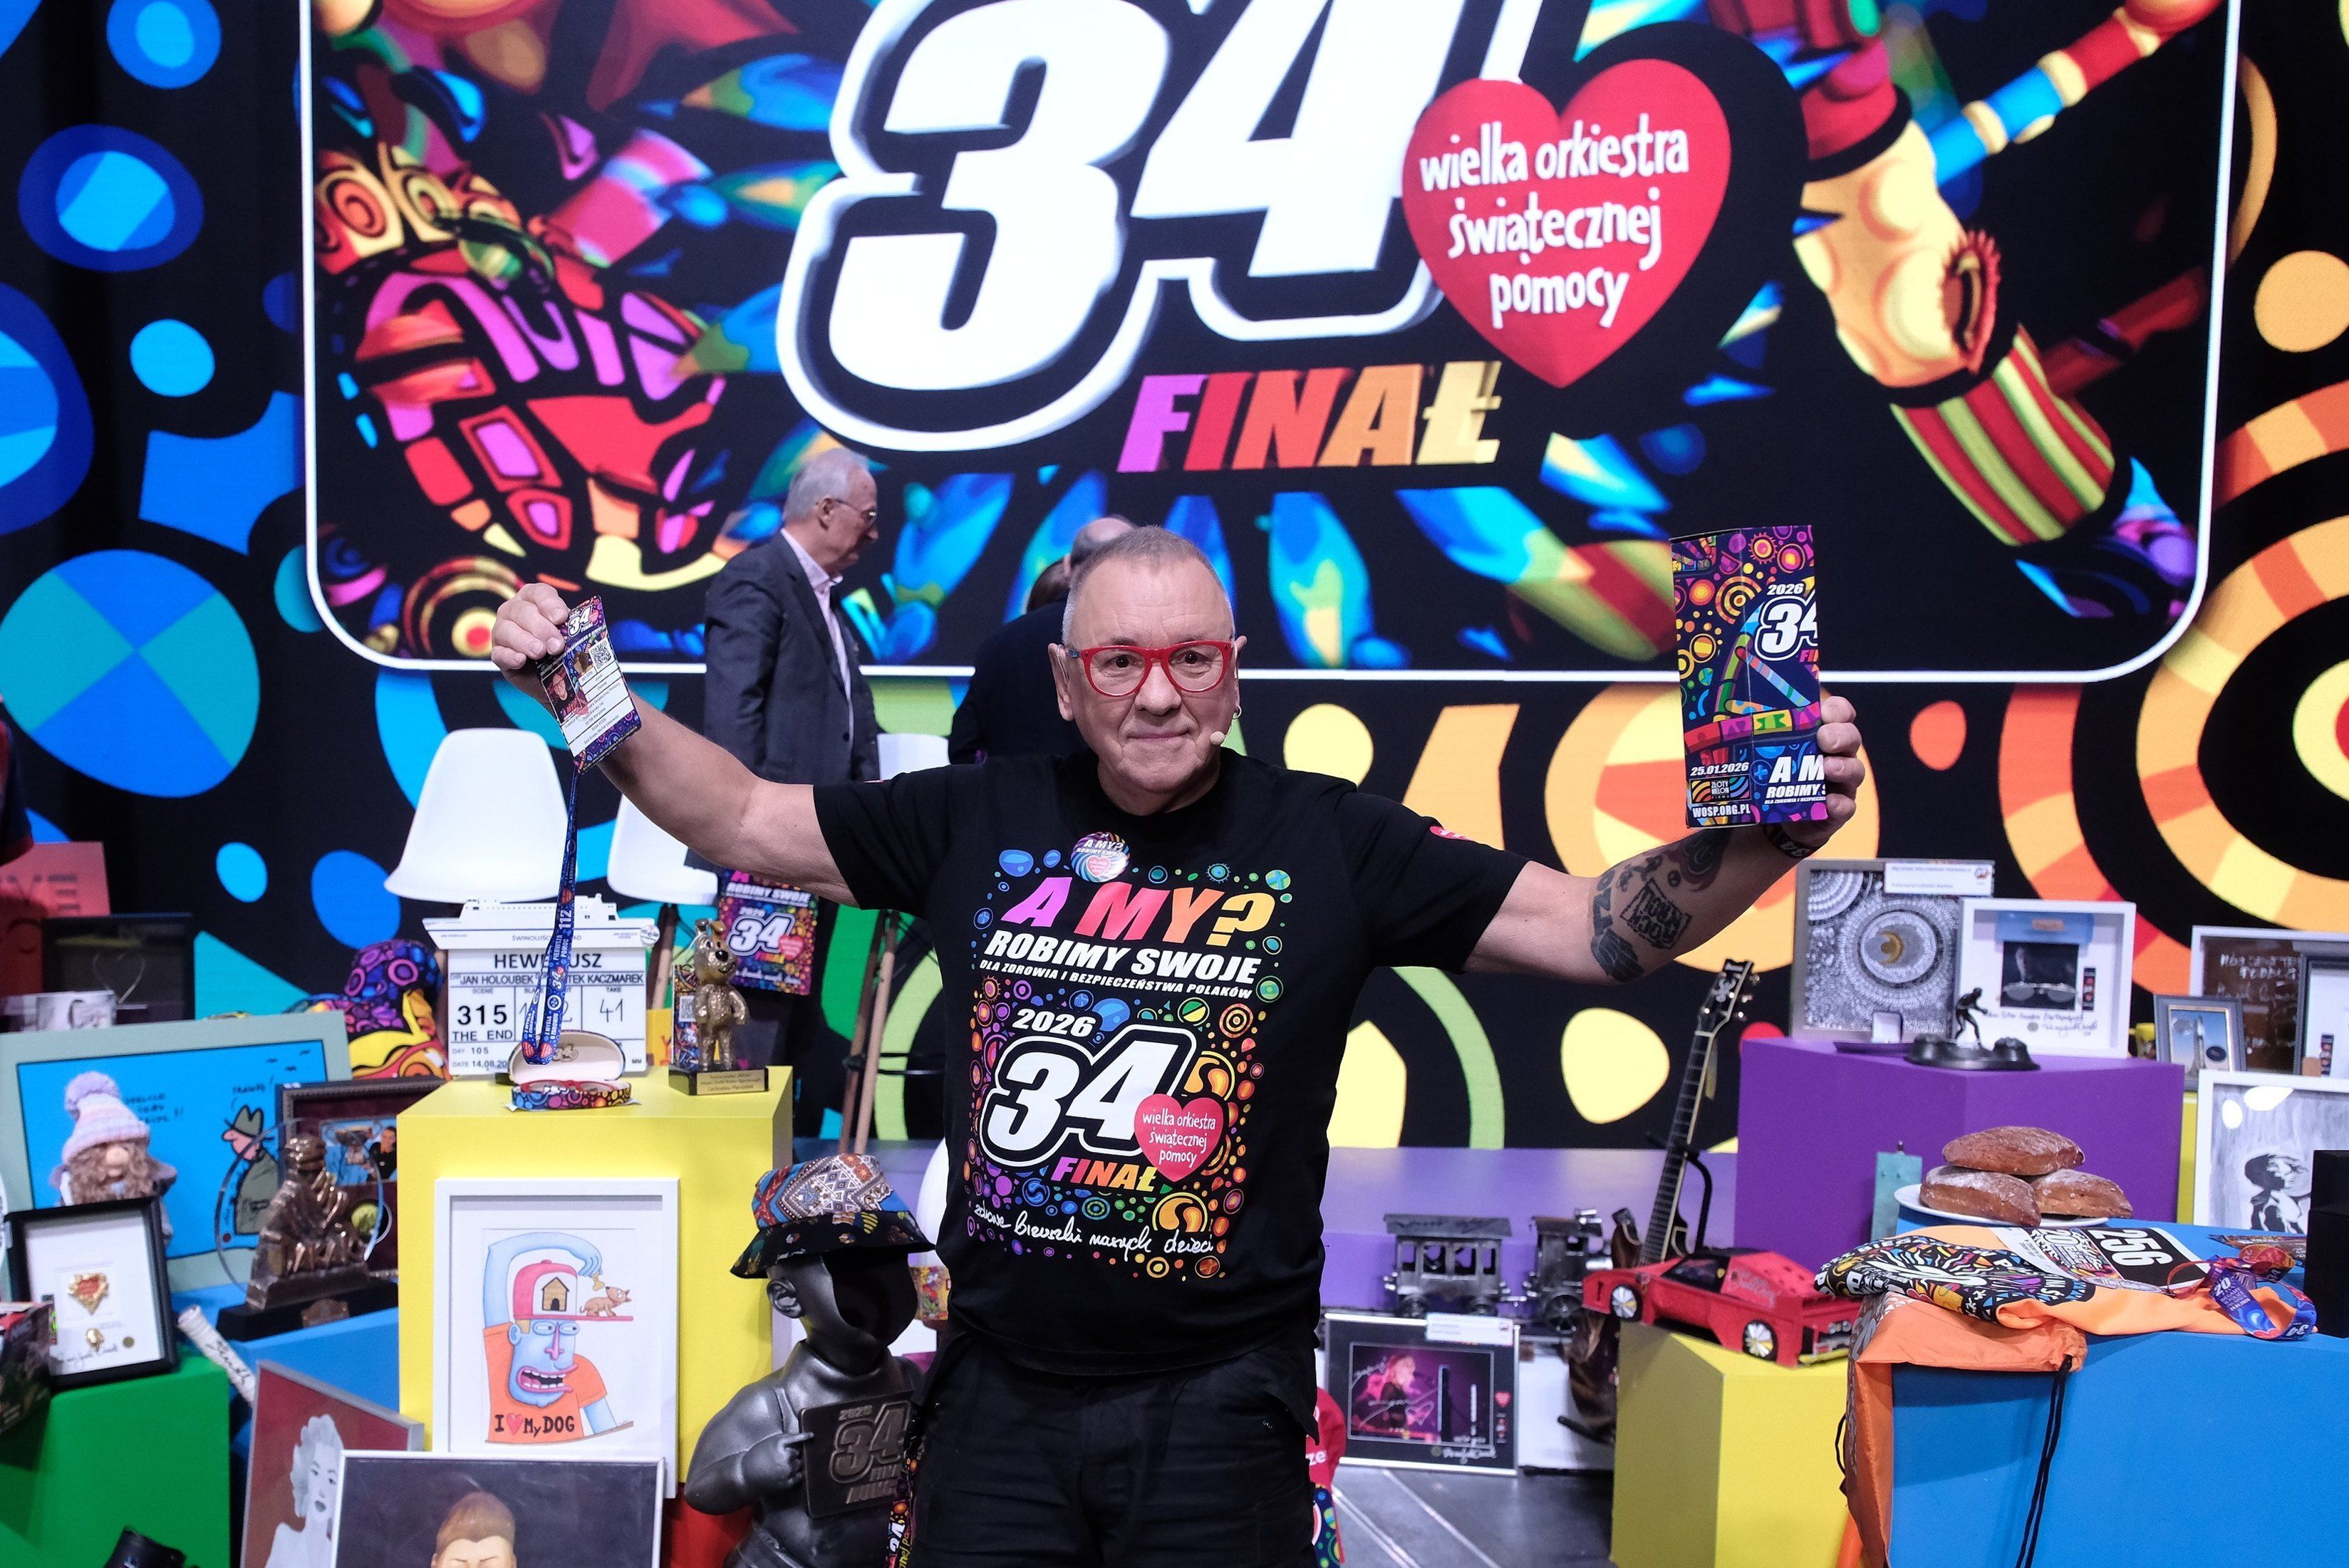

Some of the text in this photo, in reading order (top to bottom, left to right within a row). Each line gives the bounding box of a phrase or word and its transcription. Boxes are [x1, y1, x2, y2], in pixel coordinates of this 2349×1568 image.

[1420, 113, 1689, 192] wielka orkiestra
[809, 0, 1485, 413] 34
[1447, 188, 1661, 271] świątecznej
[1490, 262, 1630, 329] pomocy
[1116, 360, 1502, 472] FINAŁ
[1766, 583, 1804, 596] 2026
[569, 606, 593, 636] 34
[1690, 762, 1750, 776] 25.01.2026
[1768, 756, 1791, 784] A
[1765, 784, 1818, 799] ROBIMY
[1692, 804, 1751, 819] WOSP.ORG.PL
[1083, 839, 1124, 851] A MY?
[559, 910, 571, 929] 112
[1001, 877, 1275, 947] A MY?
[727, 913, 792, 954] 34
[560, 938, 569, 957] POMOC
[984, 930, 1262, 985] ROBIMY SWOJE
[494, 953, 602, 969] HEWEUSZ
[460, 975, 479, 985] JAN
[482, 973, 533, 985] HOLOUBEK
[551, 970, 563, 990] 34
[588, 973, 643, 984] KACZMAREK
[979, 960, 1253, 999] DLA ZDROWIA I BEZPIECZEŃSTWA POLAKÓW
[457, 1004, 507, 1025] 315
[600, 998, 623, 1023] 41
[1012, 1008, 1096, 1038] 2026
[452, 1030, 513, 1041] THE END
[472, 1060, 507, 1069] 14.08.20
[984, 1033, 1186, 1158] 34
[1143, 1108, 1216, 1130] wielka orkiestra
[1148, 1126, 1208, 1154] świątecznej
[1158, 1149, 1198, 1168] pomocy
[1051, 1156, 1158, 1192] FINAŁ
[2087, 1229, 2173, 1267] 256
[2214, 1277, 2231, 1297] 20
[494, 1414, 576, 1438] I My DOG
[834, 1406, 906, 1480] 34
